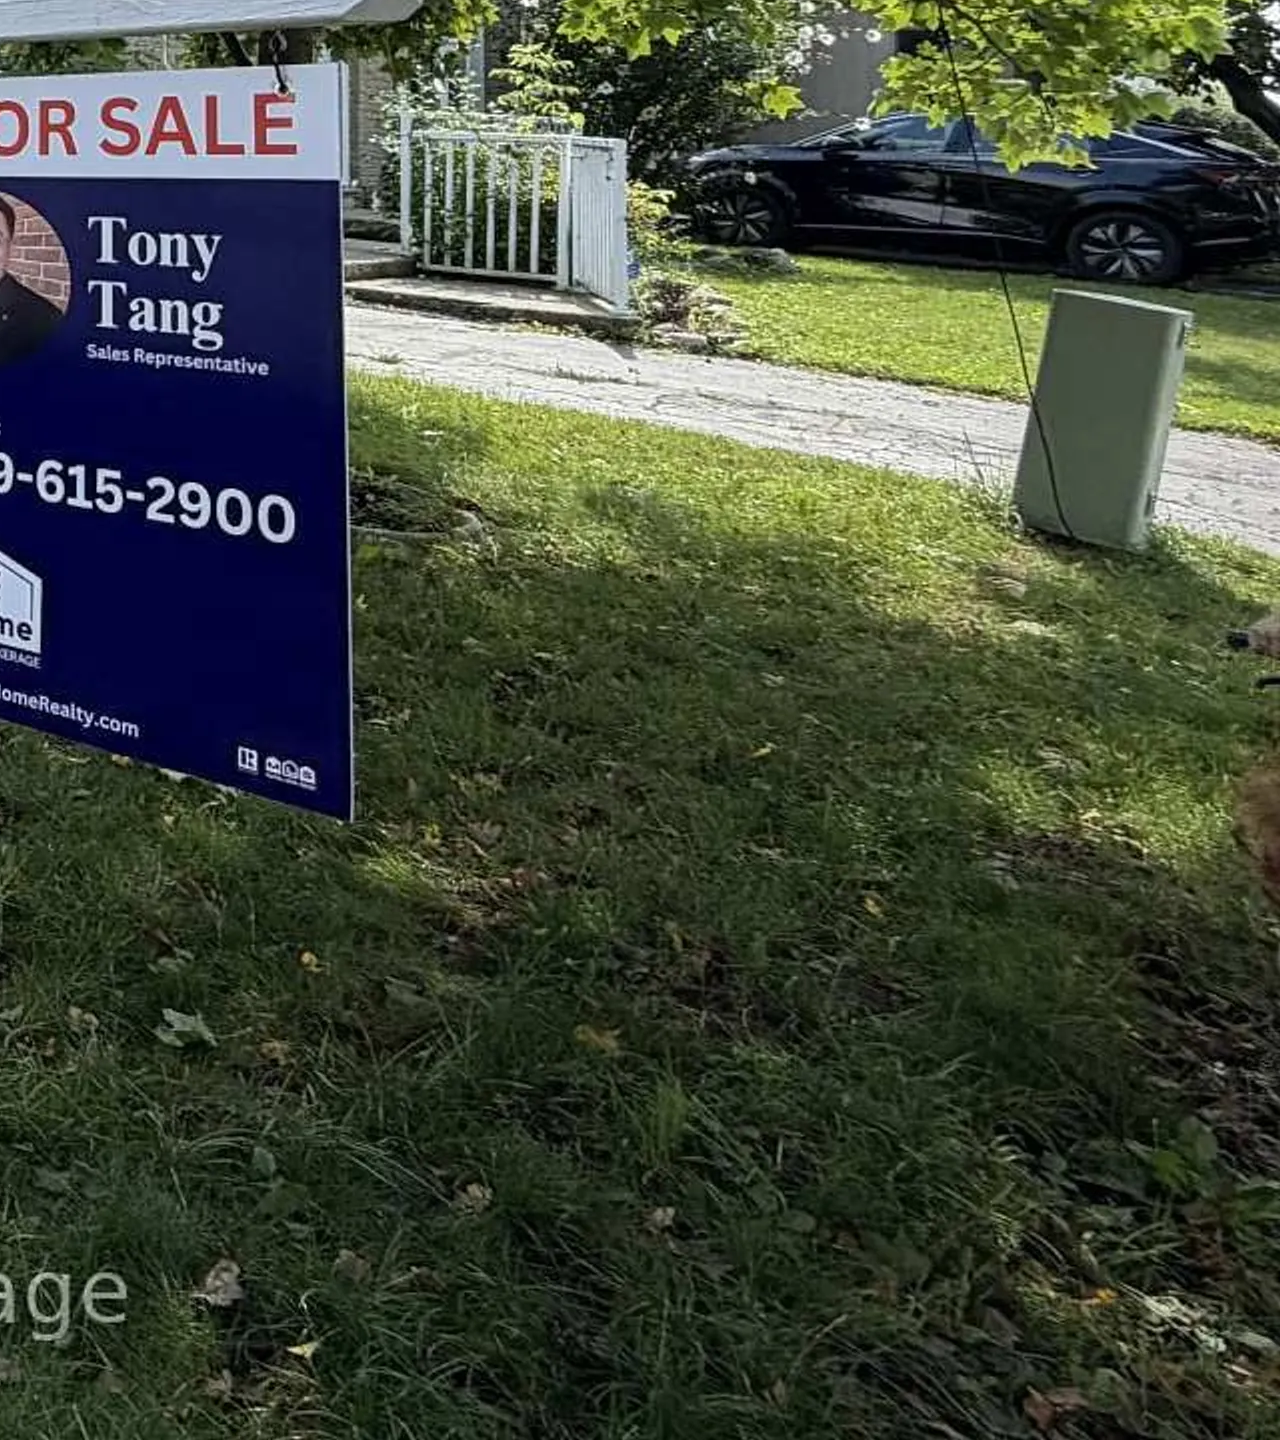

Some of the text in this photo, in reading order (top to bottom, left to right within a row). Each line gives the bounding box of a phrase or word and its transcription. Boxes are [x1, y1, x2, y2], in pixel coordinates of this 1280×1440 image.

[99, 93, 298, 157] SALE
[88, 216, 222, 282] Tony
[88, 280, 224, 351] Tang
[86, 343, 270, 376] Sales Representative
